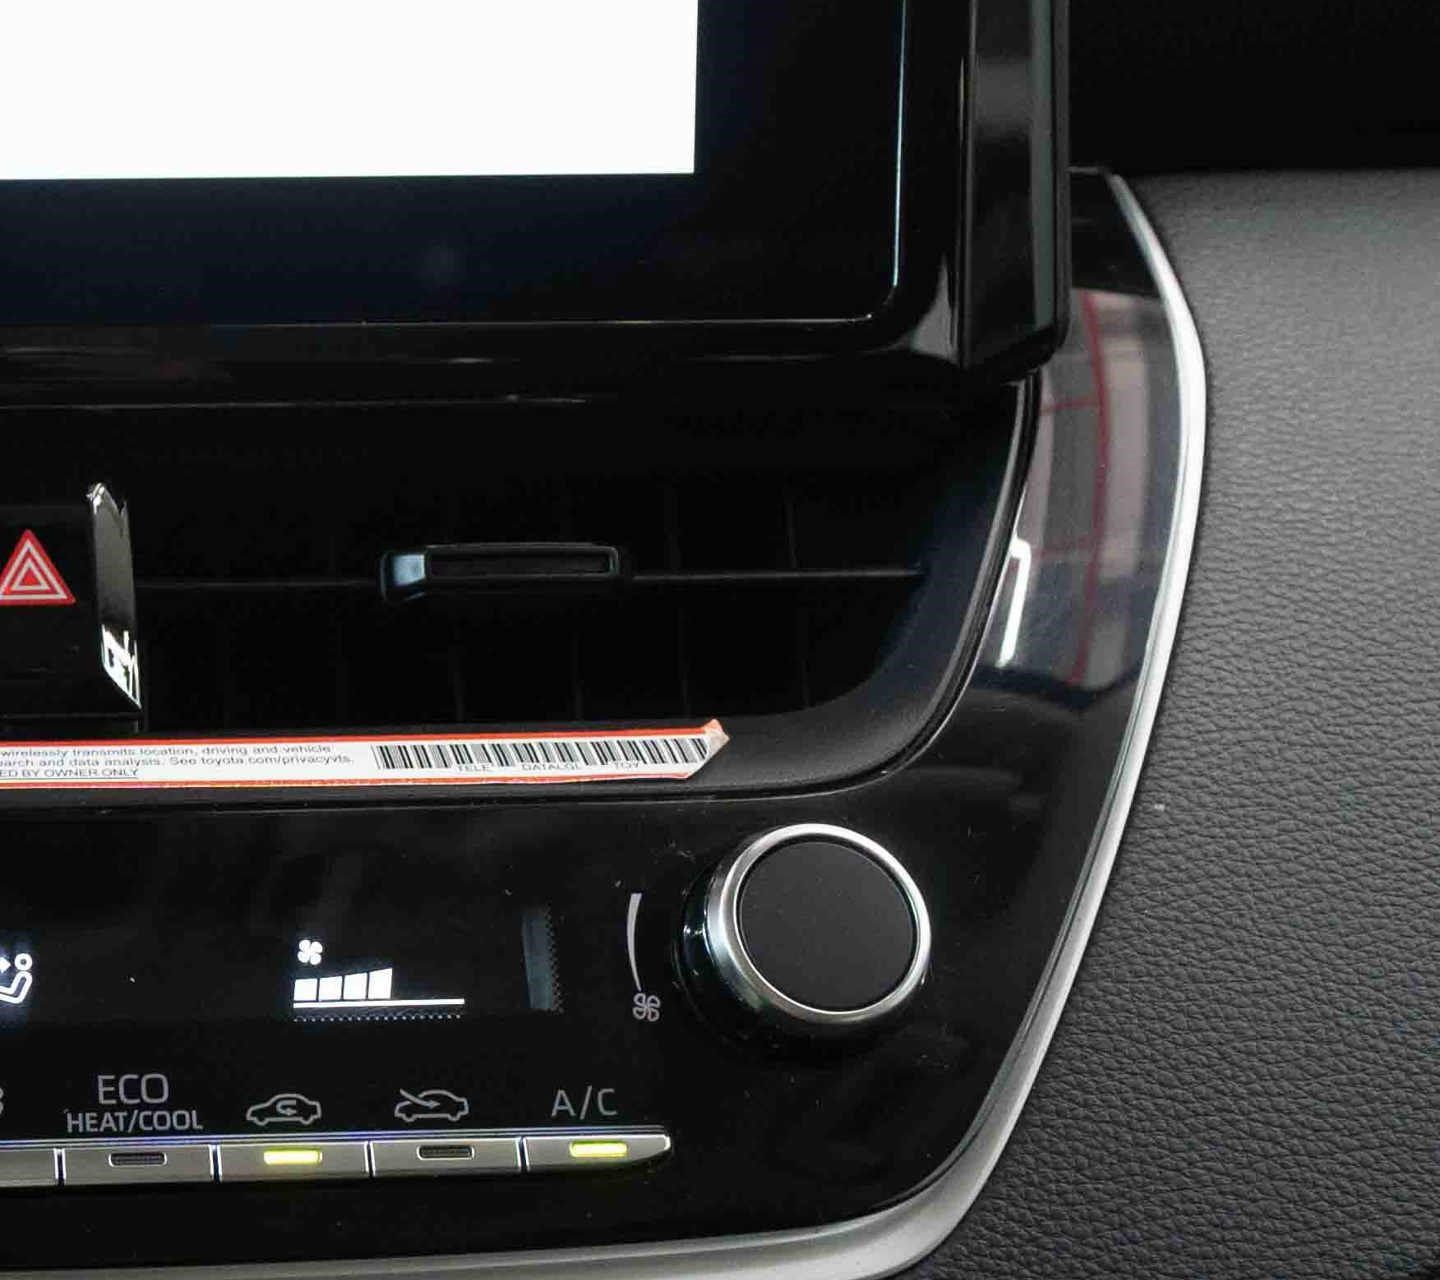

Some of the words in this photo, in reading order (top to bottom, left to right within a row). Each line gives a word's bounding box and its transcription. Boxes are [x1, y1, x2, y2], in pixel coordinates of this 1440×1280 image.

[1, 748, 68, 759] wirelessly
[73, 747, 134, 757] transmits
[202, 746, 248, 757] driving
[253, 745, 278, 755] and
[283, 744, 332, 754] vehicle
[39, 758, 64, 767] and
[69, 758, 100, 767] data
[170, 757, 197, 766] See
[44, 768, 98, 779] OWNER
[102, 768, 138, 778] ONLY
[96, 1072, 171, 1106] ECO
[550, 1084, 618, 1120] A/C
[66, 1108, 204, 1134] HEAT/COOL
